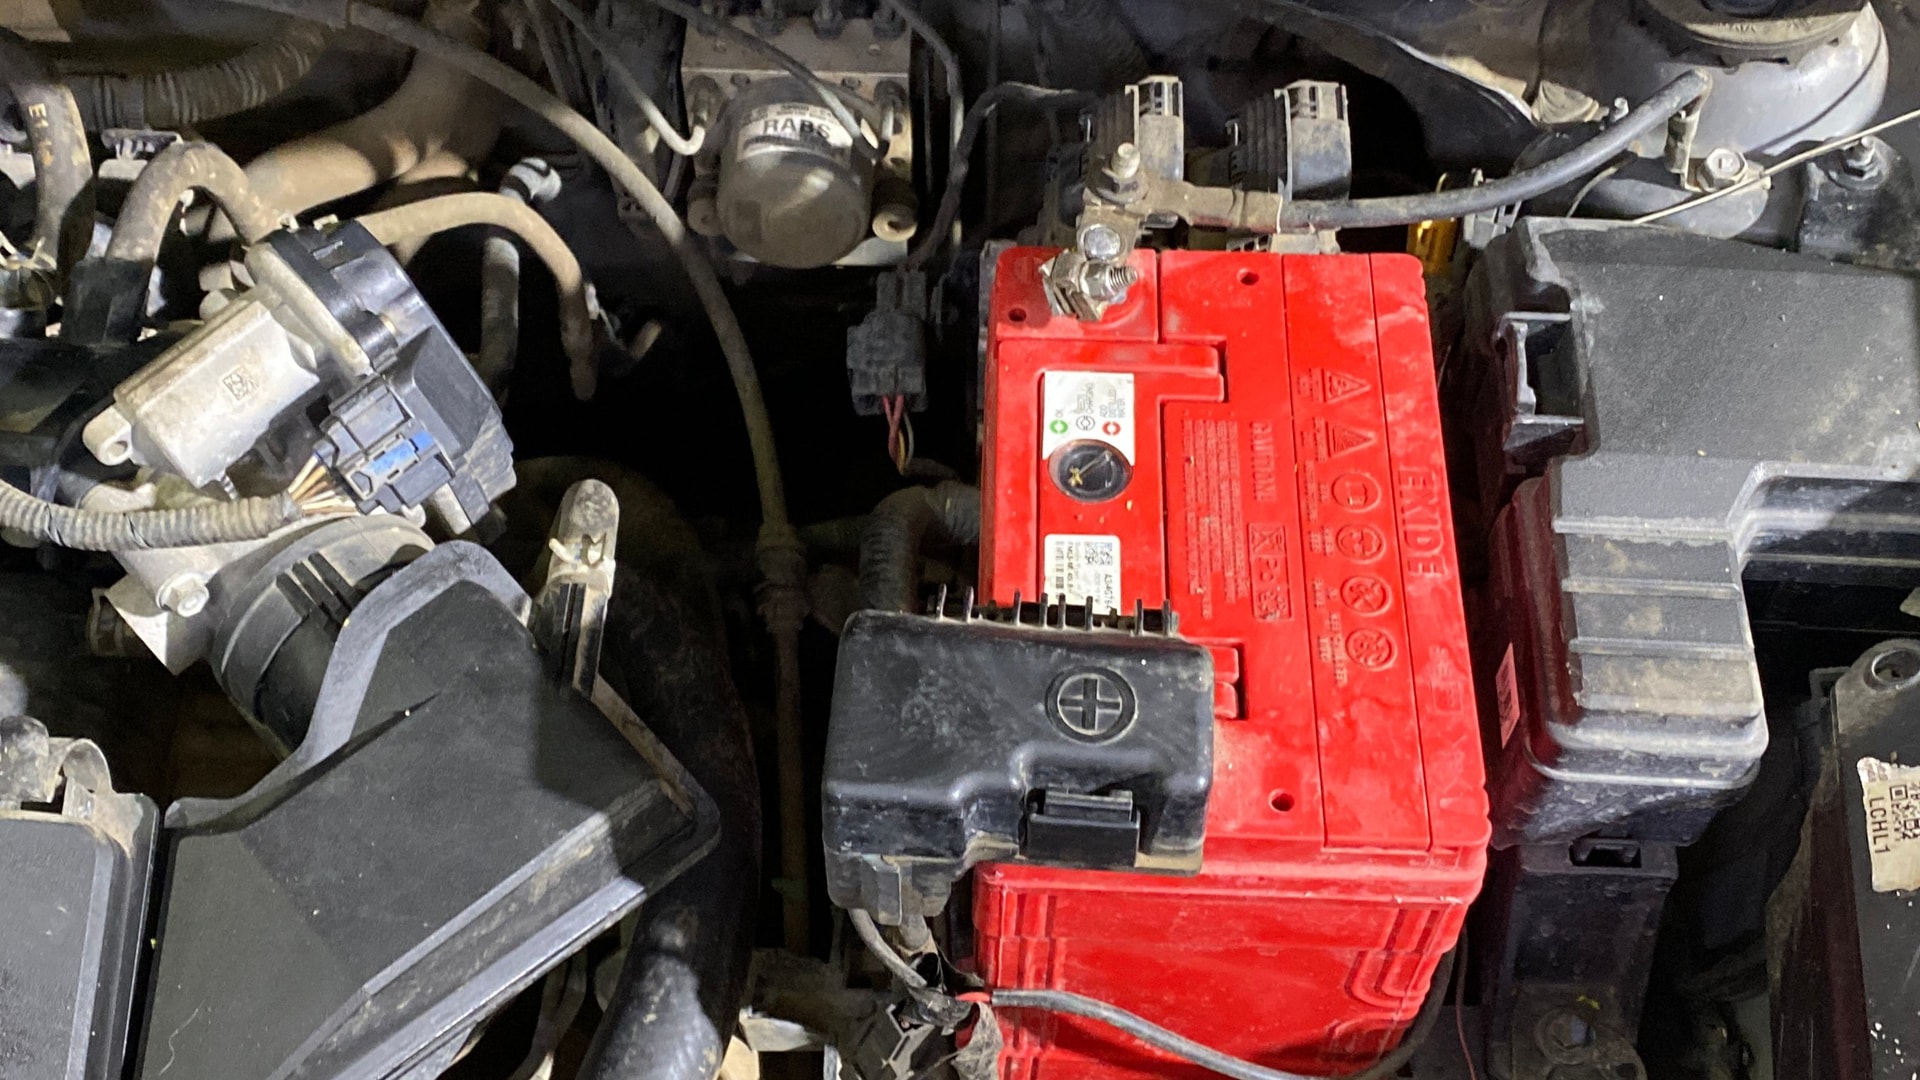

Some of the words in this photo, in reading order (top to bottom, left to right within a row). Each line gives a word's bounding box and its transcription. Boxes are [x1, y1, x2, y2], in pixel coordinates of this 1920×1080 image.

[763, 117, 831, 140] RABS
[1398, 465, 1449, 578] EXIDE
[1869, 797, 1891, 854] LCHL1
